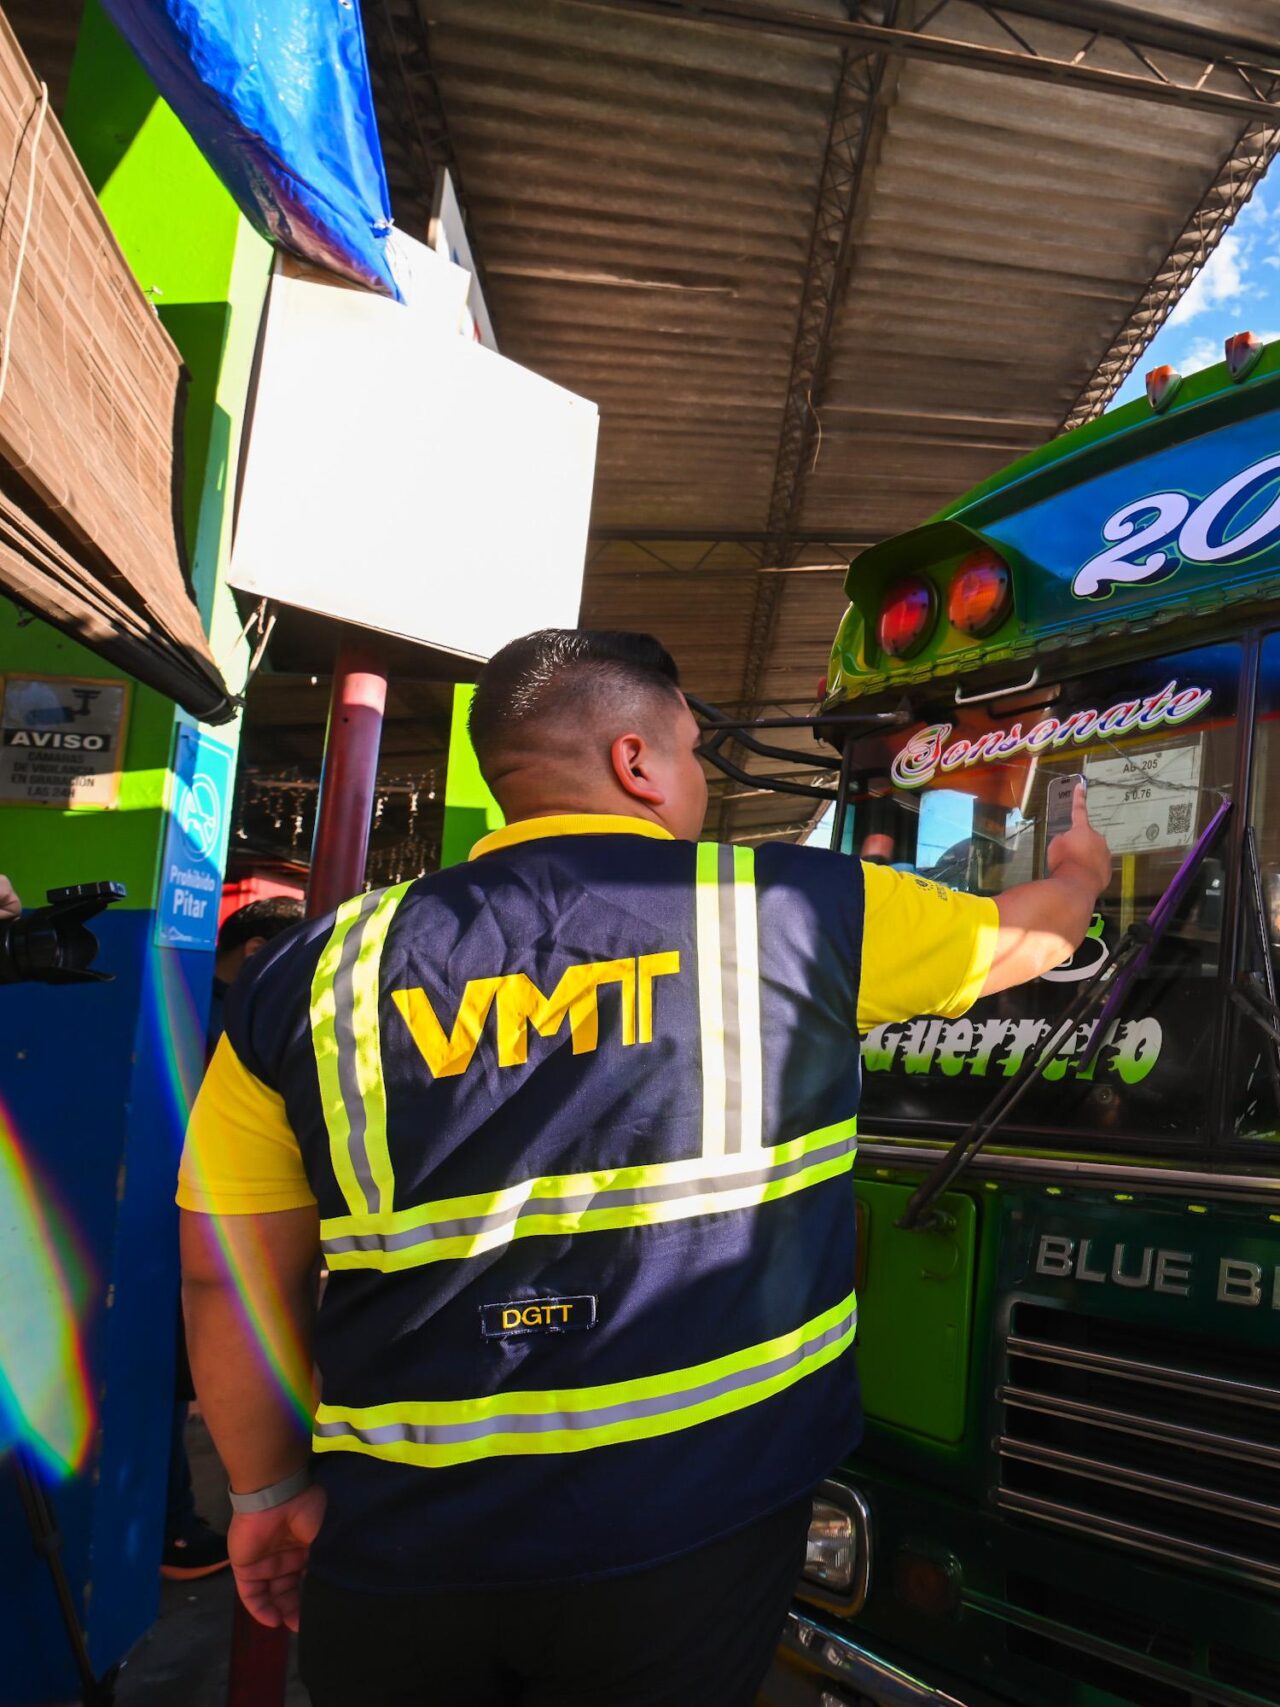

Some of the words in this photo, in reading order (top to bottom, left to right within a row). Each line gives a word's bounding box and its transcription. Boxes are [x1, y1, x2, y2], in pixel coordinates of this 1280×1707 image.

[10, 731, 104, 750] AVISO
[890, 679, 1213, 789] Sonsonate
[1142, 759, 1158, 771] 205
[169, 864, 215, 892] Prohibido
[172, 888, 208, 918] Pitar
[390, 951, 680, 1079] VMT
[1035, 1234, 1193, 1297] BLUE
[502, 1304, 573, 1329] DGTT
